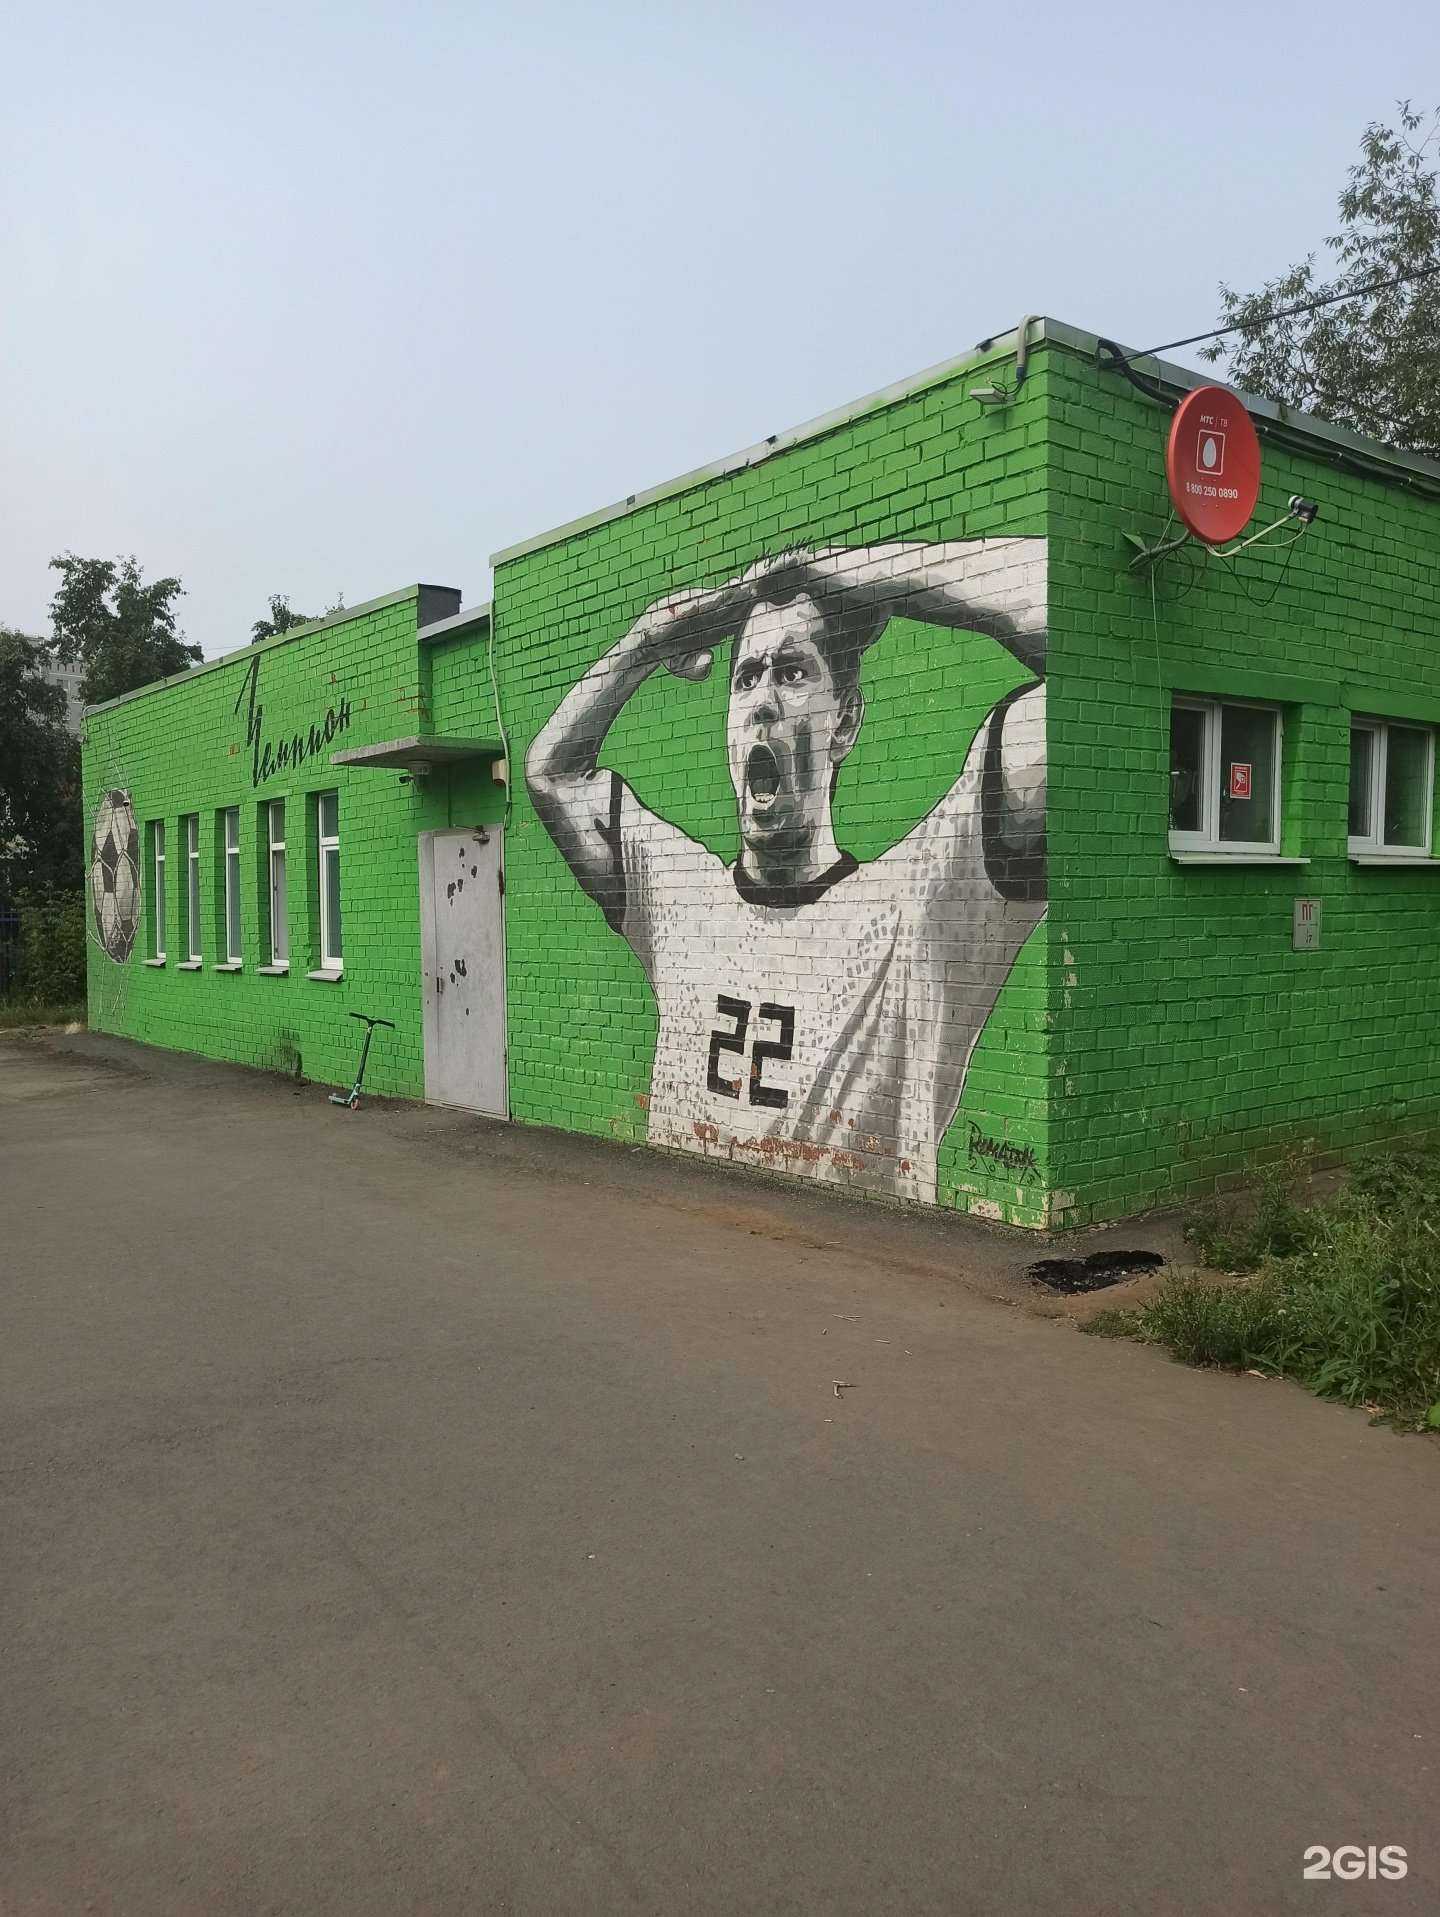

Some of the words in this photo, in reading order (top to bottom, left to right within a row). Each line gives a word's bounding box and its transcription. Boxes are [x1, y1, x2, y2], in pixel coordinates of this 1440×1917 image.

[1200, 415, 1214, 425] МТС
[1191, 483, 1202, 495] 800
[1203, 486, 1217, 497] 250
[1218, 487, 1238, 499] 0890
[1302, 903, 1313, 921] ПГ
[707, 993, 795, 1109] 22
